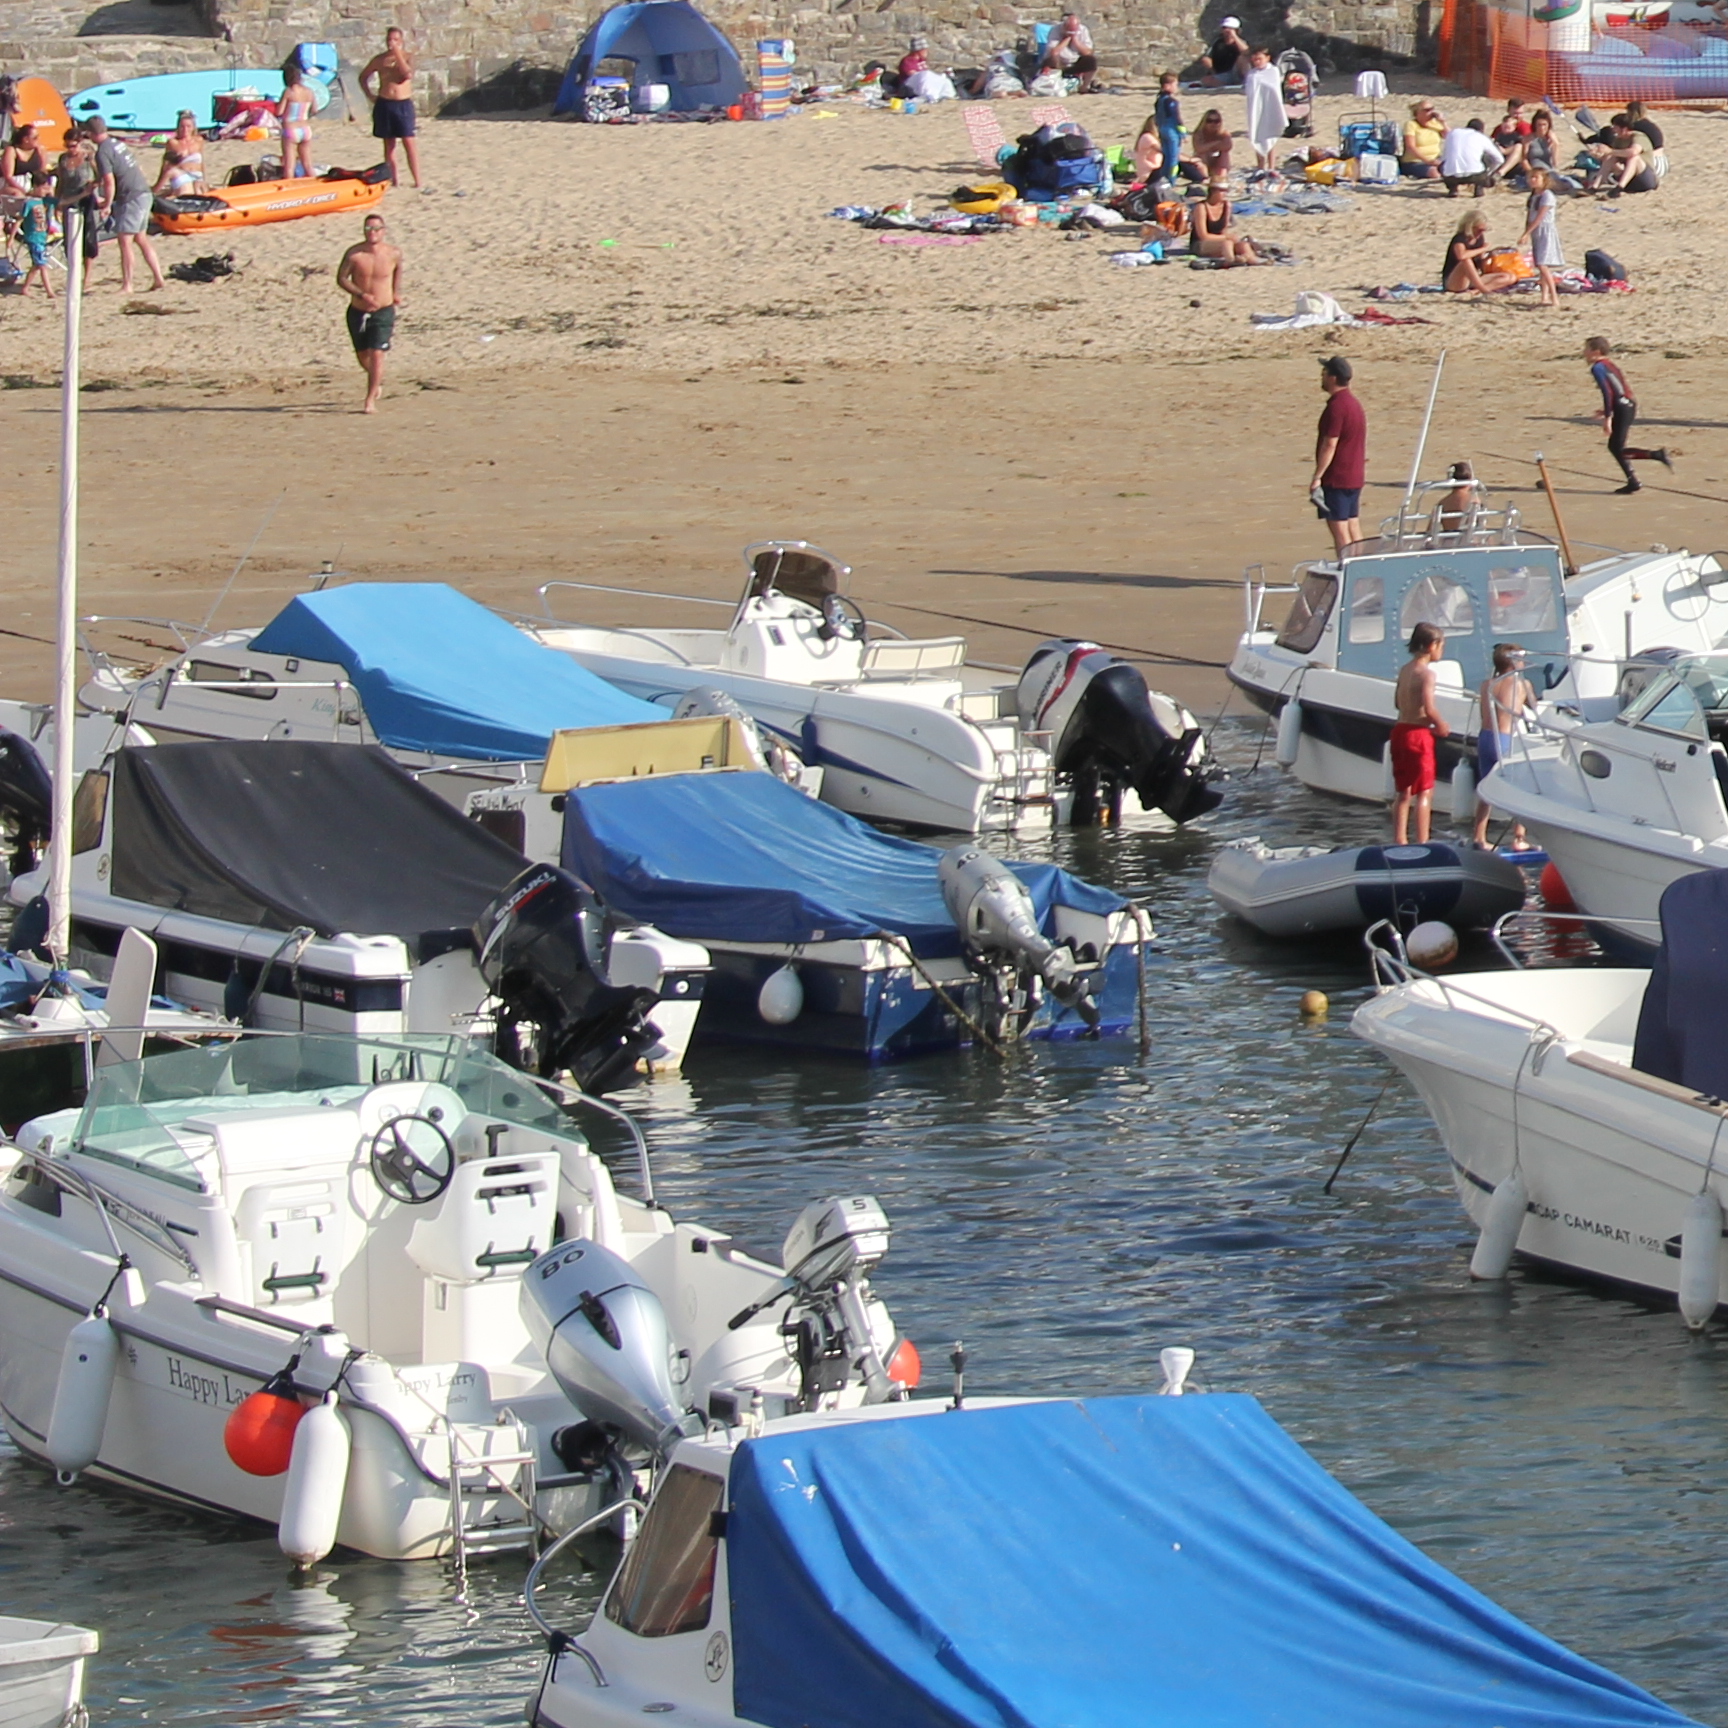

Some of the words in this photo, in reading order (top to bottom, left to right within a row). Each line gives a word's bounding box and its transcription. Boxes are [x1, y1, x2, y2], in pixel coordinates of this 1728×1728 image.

[494, 871, 550, 921] SUZUKI
[852, 1198, 867, 1211] 5
[1536, 1206, 1560, 1221] CAP
[1564, 1212, 1632, 1245] CAMARAT
[542, 1249, 586, 1280] 80
[166, 1356, 219, 1406] Happy
[434, 1371, 478, 1390] Larry
